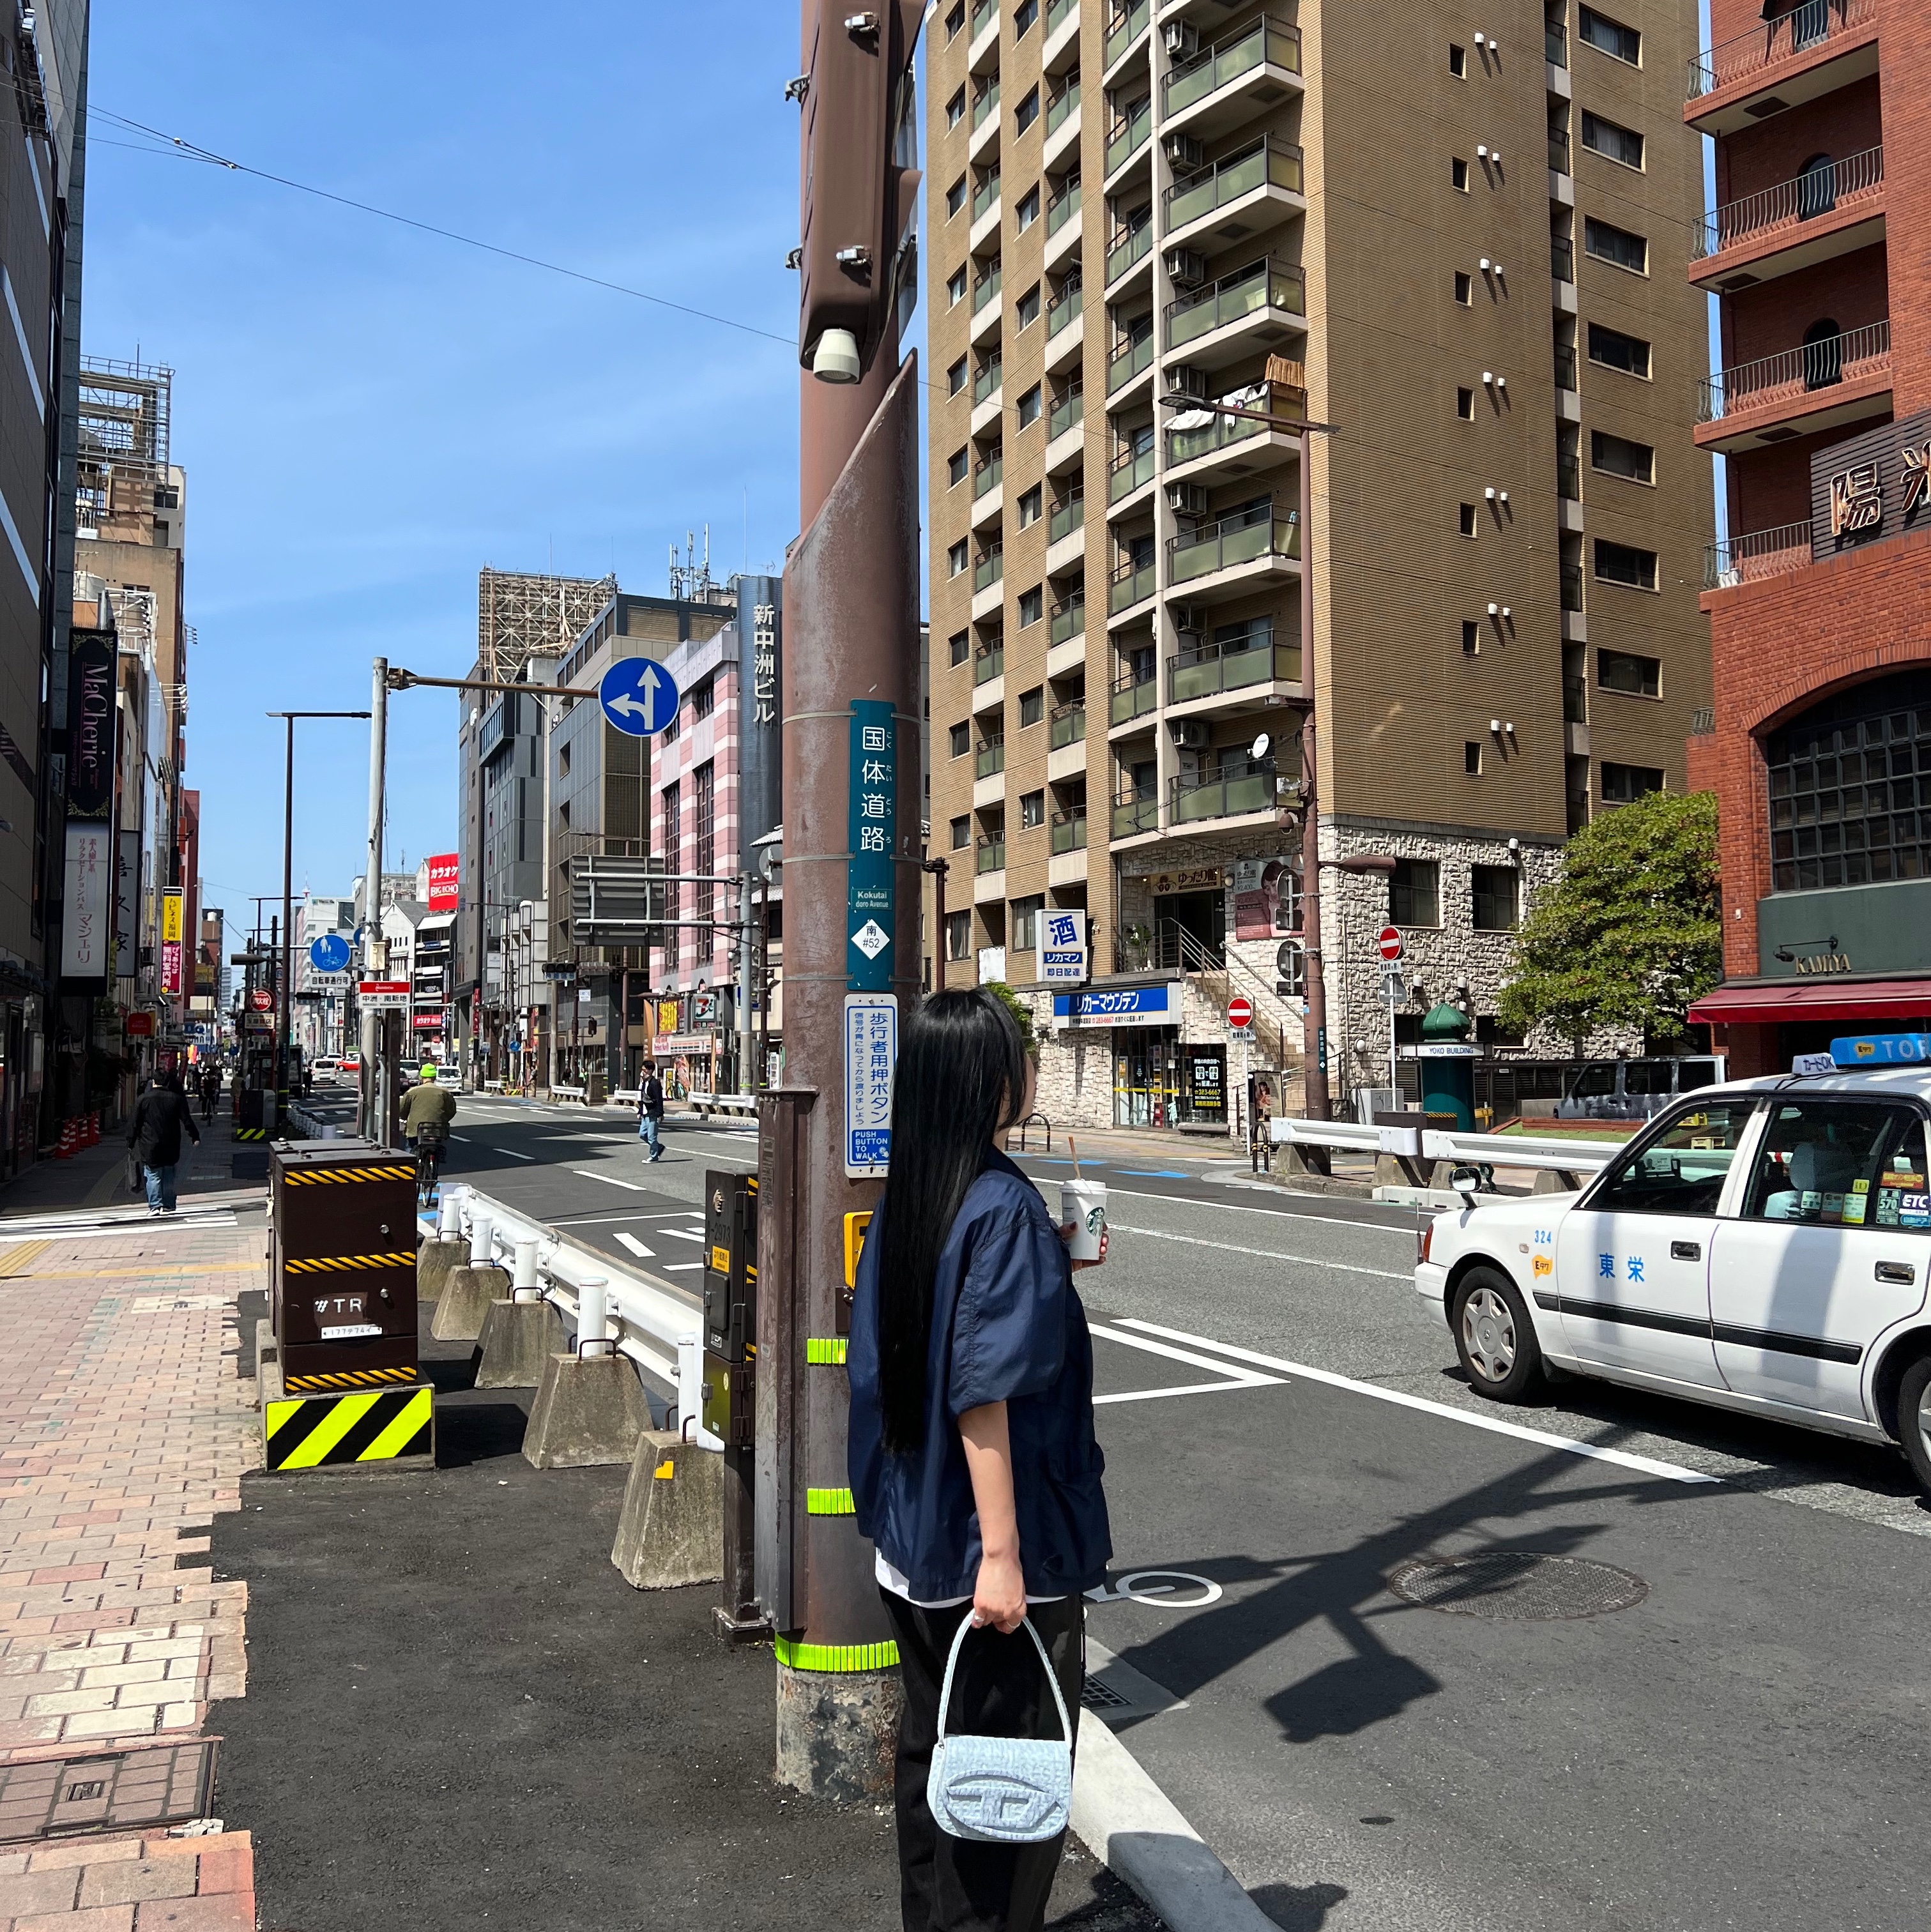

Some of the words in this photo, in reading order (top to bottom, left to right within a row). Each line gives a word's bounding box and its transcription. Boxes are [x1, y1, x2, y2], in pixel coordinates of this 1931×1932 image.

[753, 604, 775, 723] 新中洲ビル
[82, 662, 109, 768] MaCherie
[861, 726, 886, 851] 国体道路
[431, 865, 459, 879] カラオケ
[430, 886, 442, 897] BIG
[442, 883, 459, 894] ECHO
[857, 890, 887, 899] Kokutai
[869, 900, 889, 908] Avenue
[866, 926, 877, 936] 南
[1048, 915, 1078, 947] 酒
[862, 938, 880, 948] #52
[1047, 953, 1080, 962] リカマン
[1796, 954, 1852, 975] KAMIYA
[162, 947, 172, 987] 無料案内所
[1047, 968, 1080, 977] 即日配達
[312, 977, 348, 985] 自転車通行可
[1076, 991, 1140, 1013] リカーマウンテン
[1446, 1046, 1474, 1054] BUILDING
[854, 1012, 864, 1125] 信号が青になってから渡りましょう
[869, 1012, 889, 1124] 歩行者用押ボタン
[1879, 1198, 1897, 1210] 570
[1902, 1194, 1929, 1208] ETC
[1534, 1229, 1552, 1244] 324
[1599, 1252, 1645, 1282] 東栄
